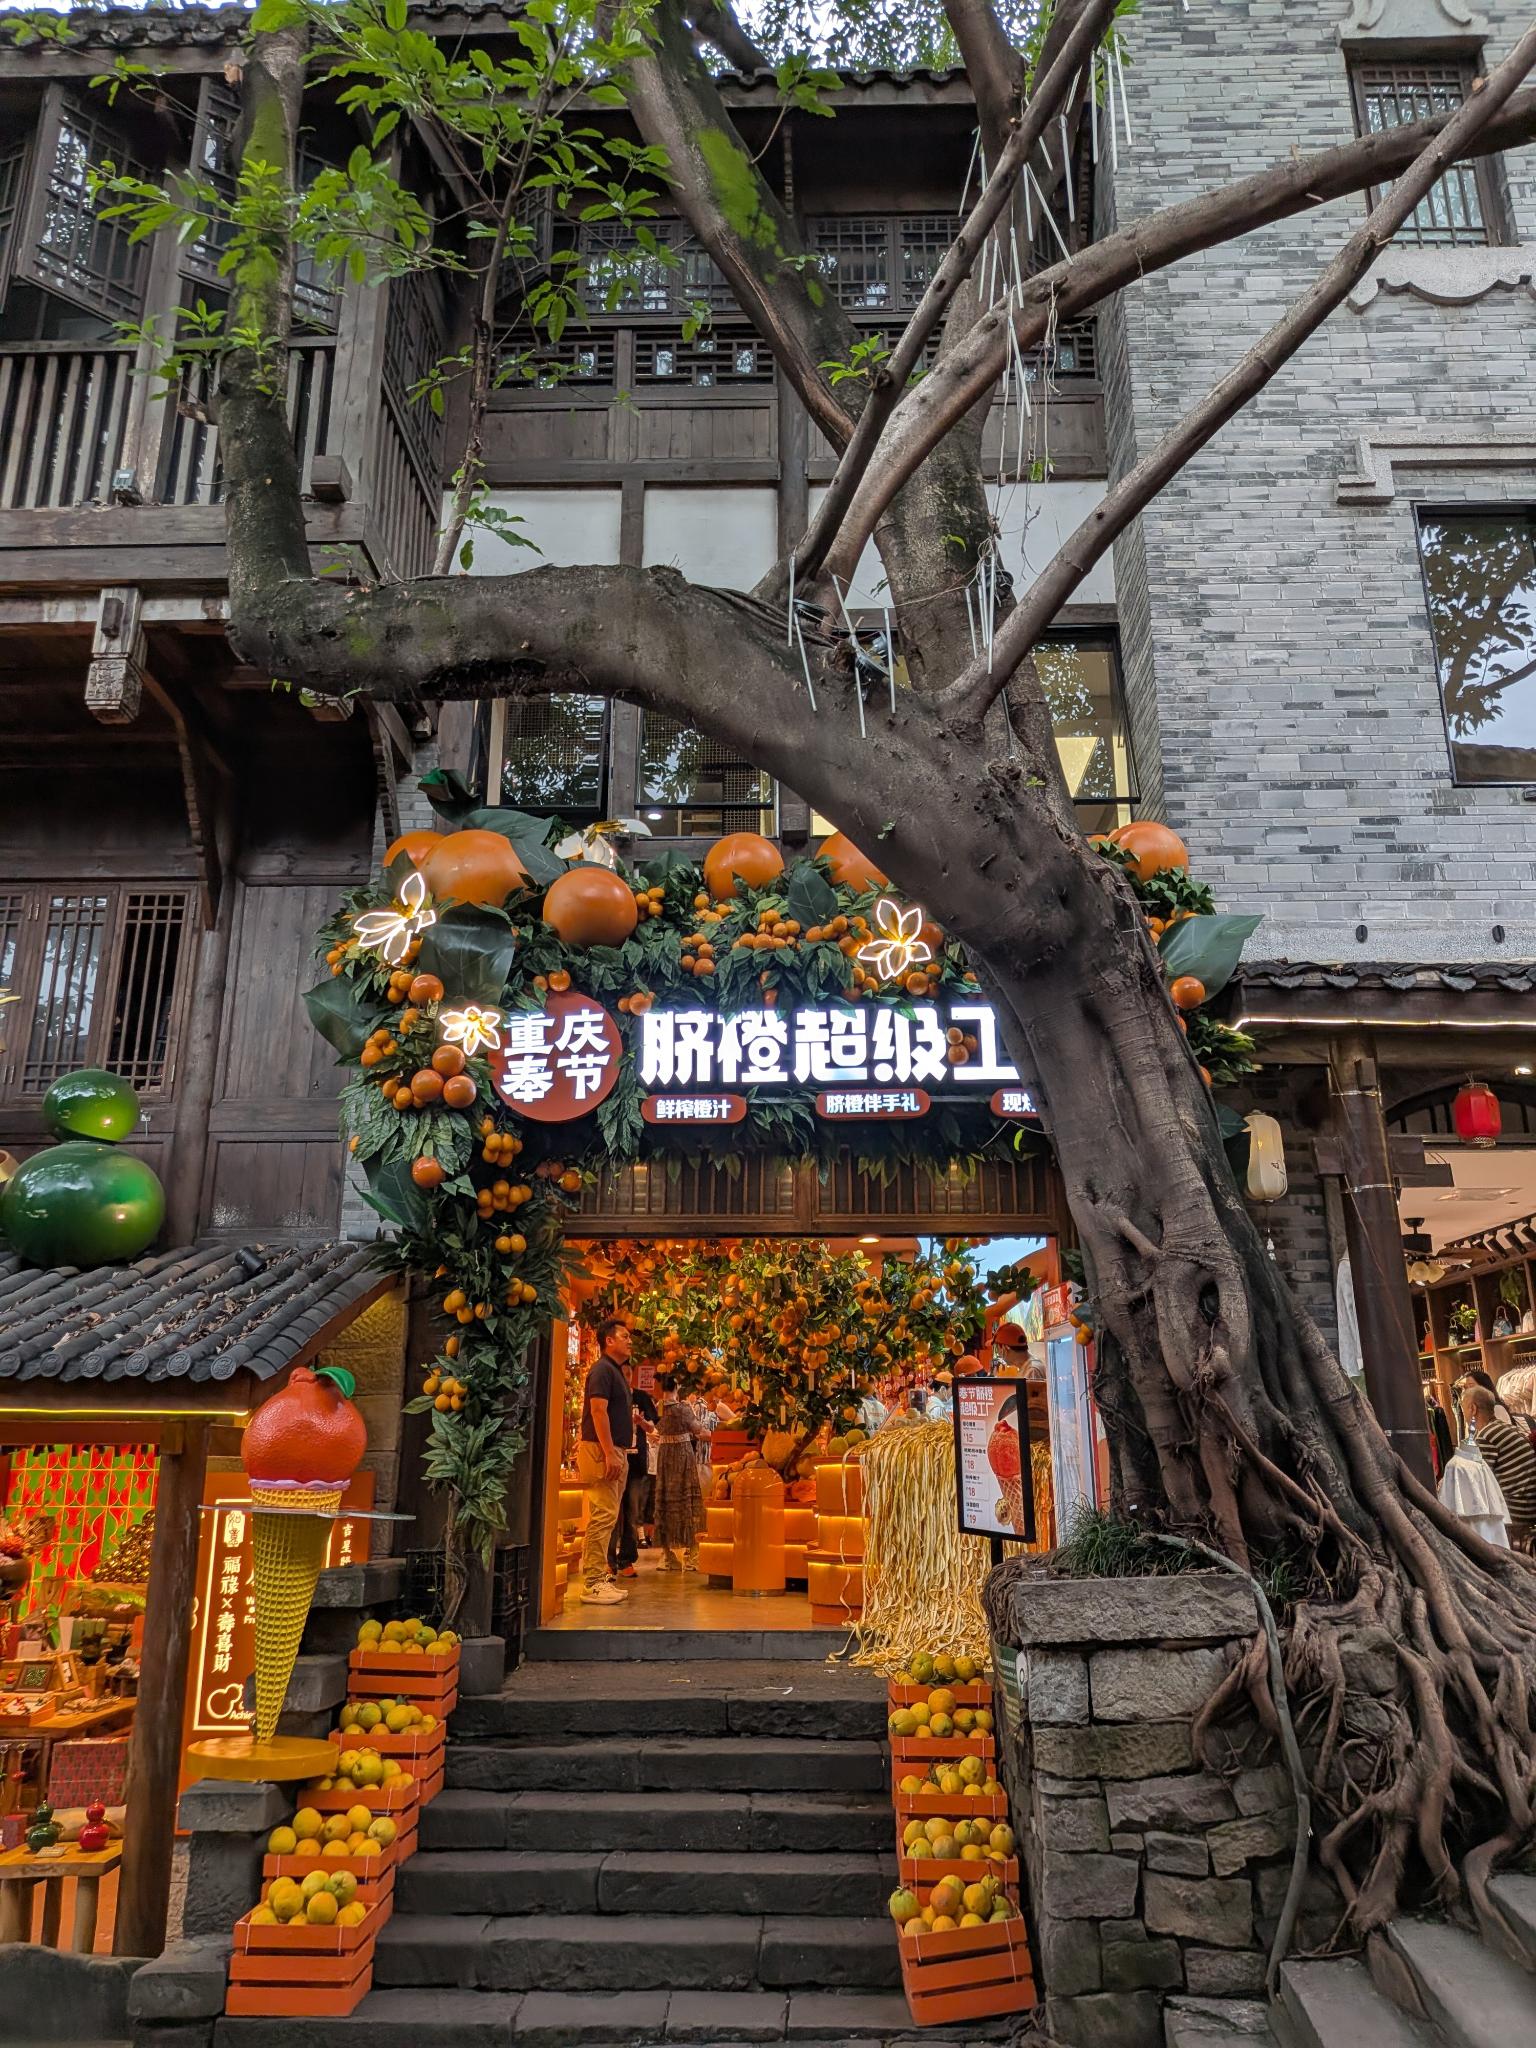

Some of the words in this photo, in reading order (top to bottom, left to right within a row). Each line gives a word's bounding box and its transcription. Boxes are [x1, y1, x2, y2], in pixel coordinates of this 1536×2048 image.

[504, 1008, 609, 1056] 重庆
[501, 1054, 610, 1103] 奉节
[655, 1097, 731, 1120] 鲜榨橙汁
[825, 1093, 920, 1115] 脐橙伴手礼
